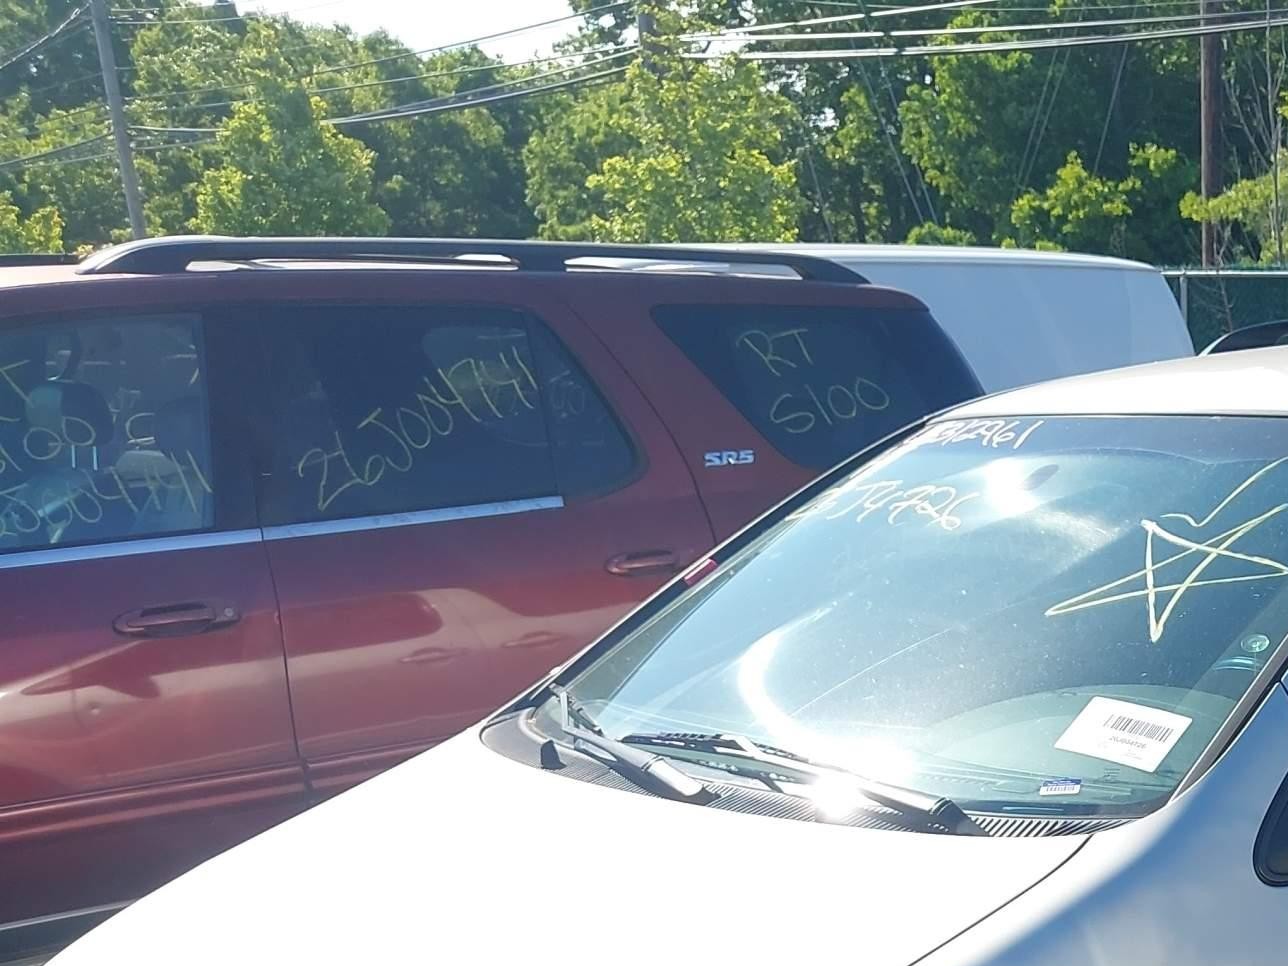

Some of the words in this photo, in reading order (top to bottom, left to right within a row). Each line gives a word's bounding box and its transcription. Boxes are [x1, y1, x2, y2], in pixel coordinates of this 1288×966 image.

[736, 328, 814, 377] RT
[296, 345, 539, 512] 26J004741
[703, 448, 756, 467] SR5
